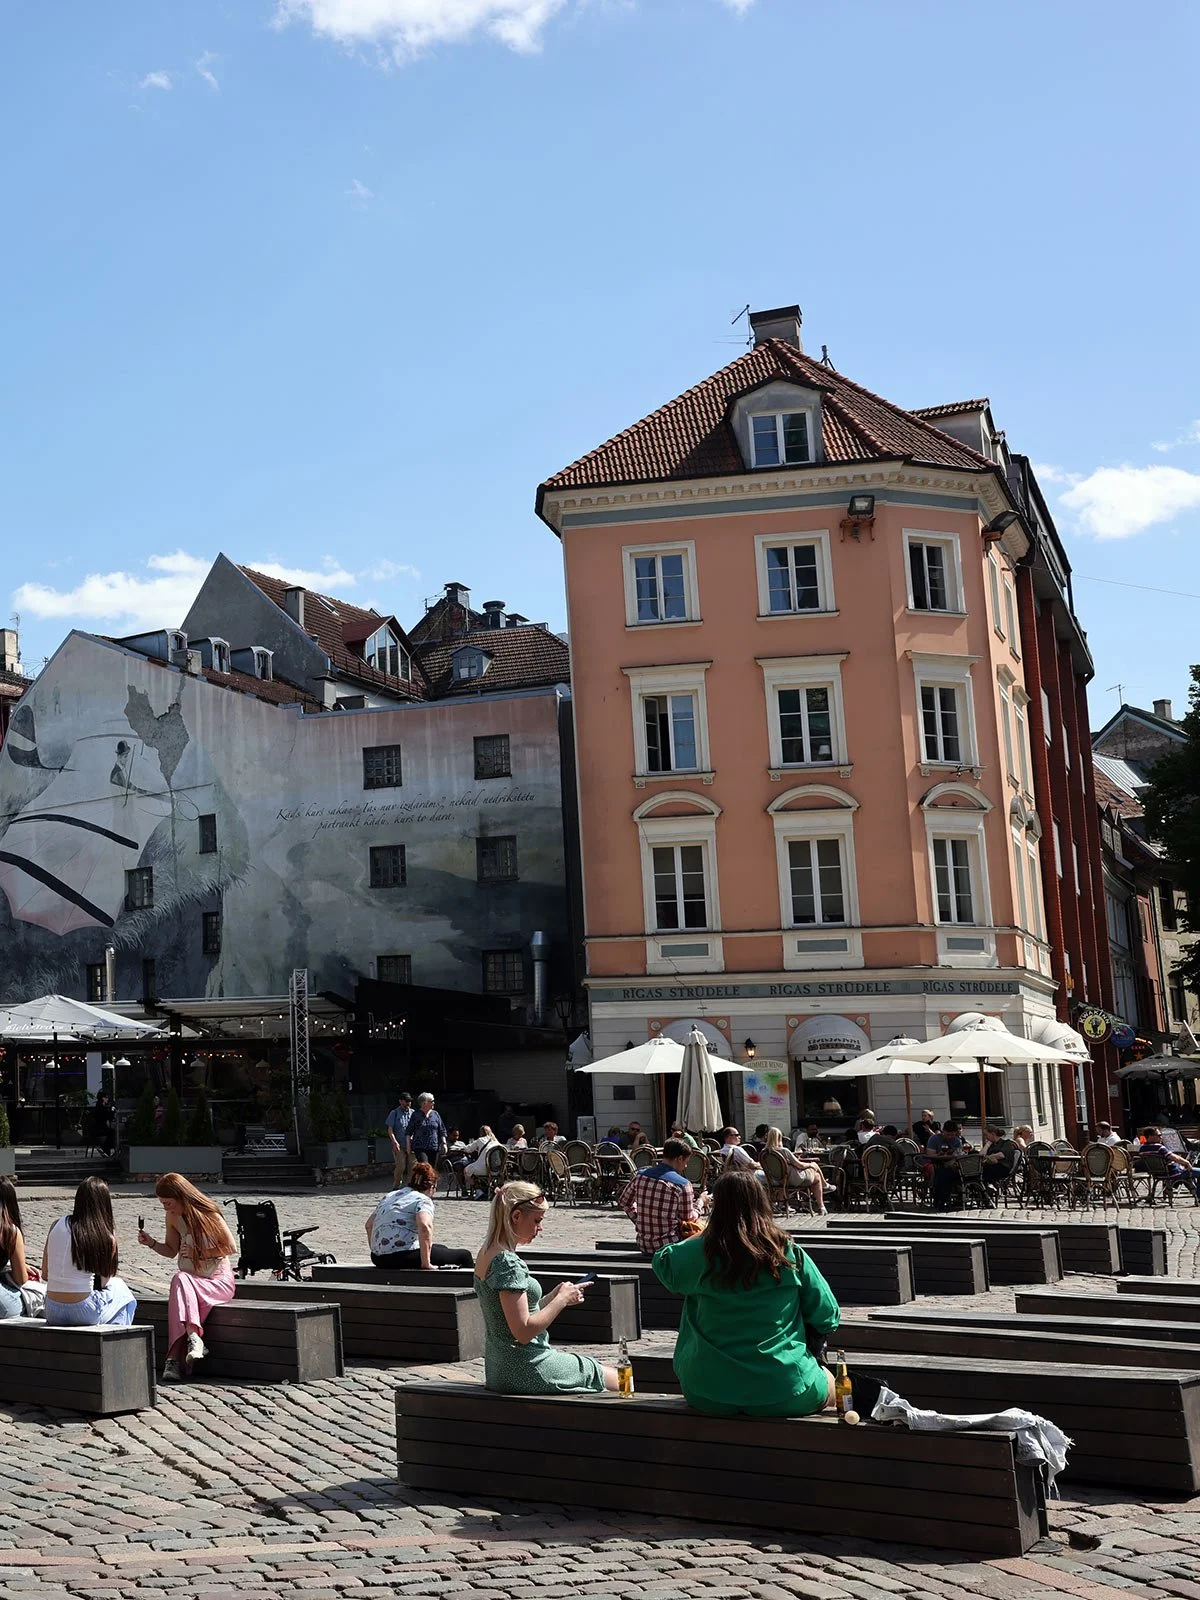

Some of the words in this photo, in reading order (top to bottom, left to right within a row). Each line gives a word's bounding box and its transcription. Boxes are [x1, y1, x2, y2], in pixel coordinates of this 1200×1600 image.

[623, 987, 662, 999] RĪGAS
[670, 985, 740, 998] STRŪDELE
[770, 983, 811, 995] RĪGAS
[818, 981, 891, 994] STRŪDELE
[923, 980, 954, 992] RĪGAS
[960, 980, 1013, 993] STRŪDELE
